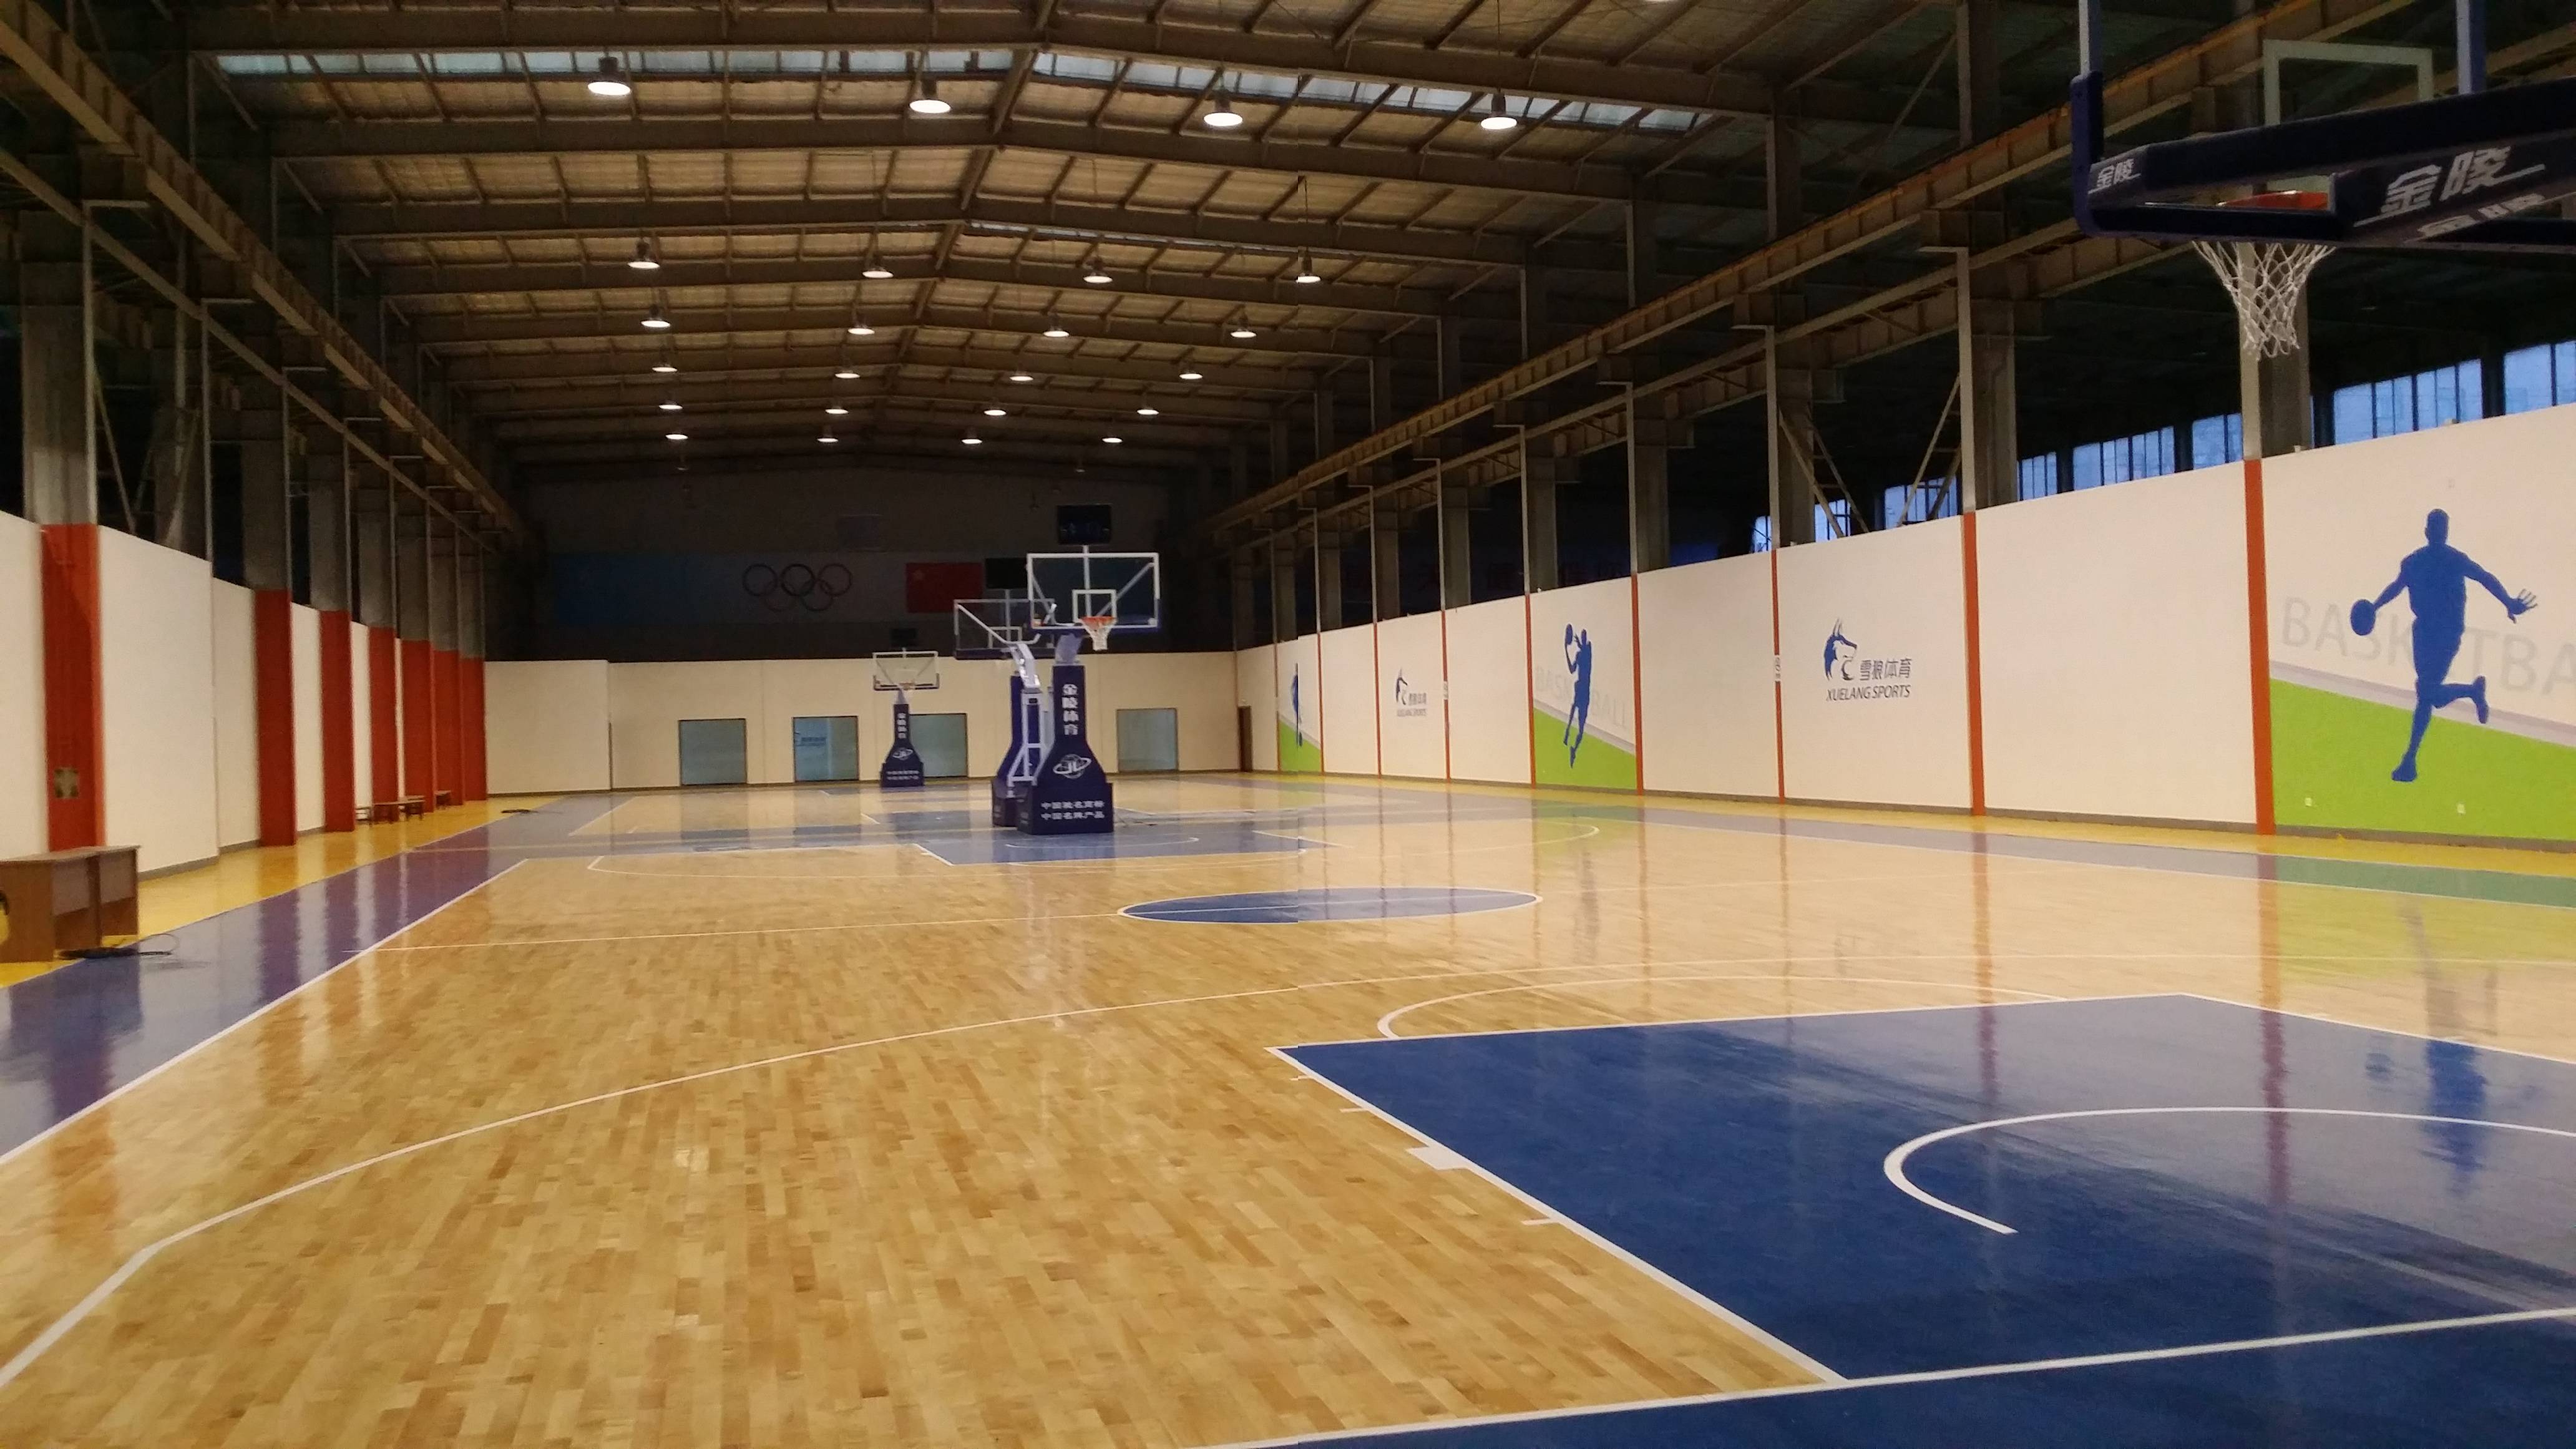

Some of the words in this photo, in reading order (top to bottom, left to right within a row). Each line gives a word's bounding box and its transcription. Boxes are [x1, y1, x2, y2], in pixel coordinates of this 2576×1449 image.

[2097, 158, 2135, 187] 金陵
[2380, 145, 2512, 214] 金陵
[1826, 686, 1871, 701] XUELANG
[1871, 685, 1911, 699] SPORTS
